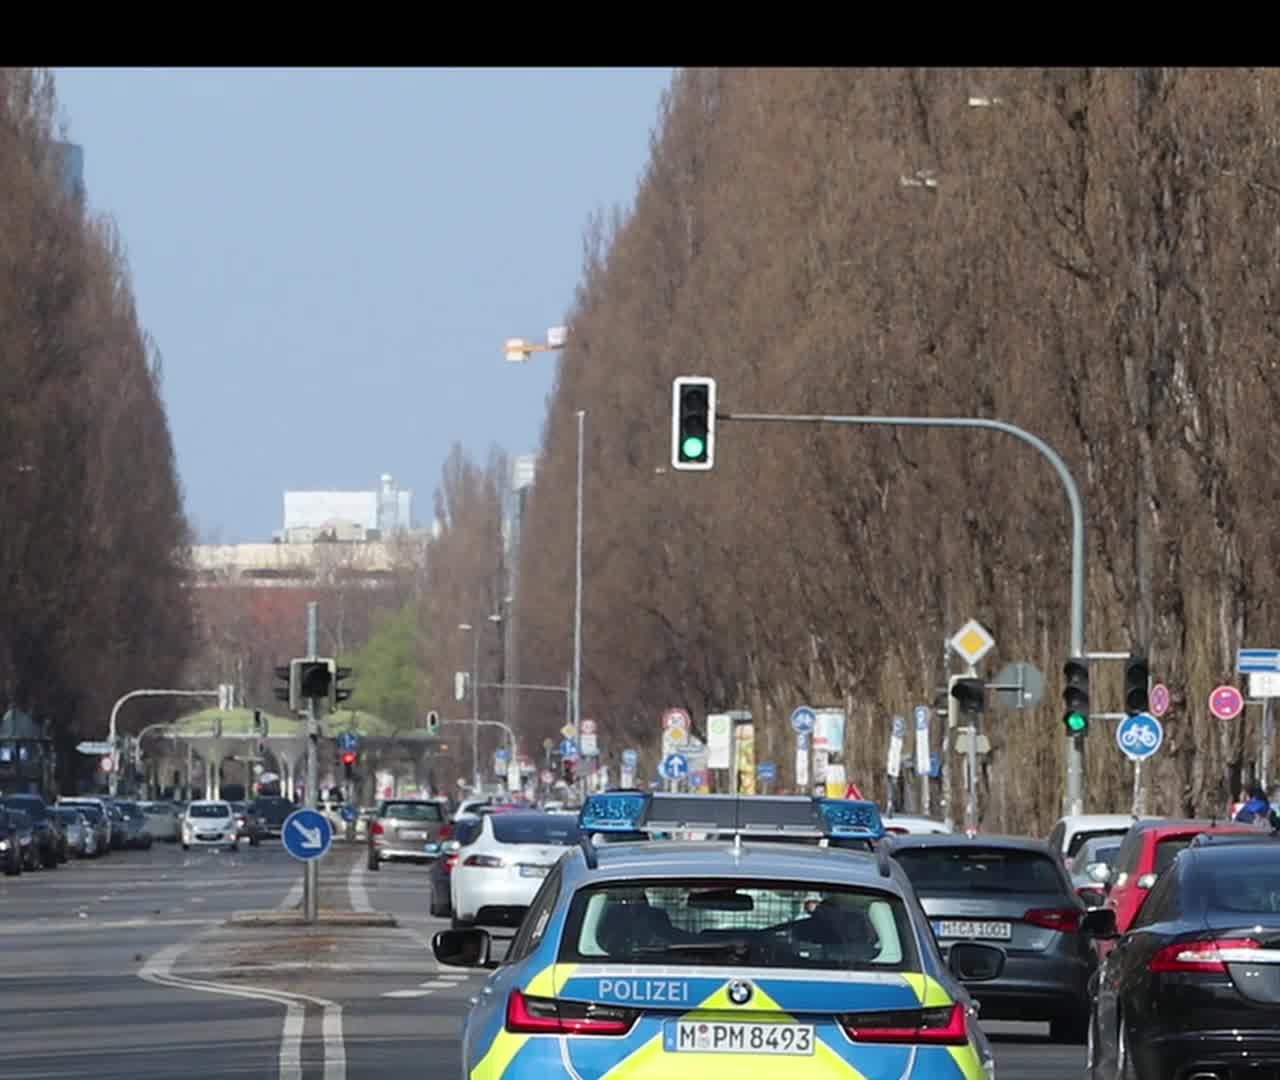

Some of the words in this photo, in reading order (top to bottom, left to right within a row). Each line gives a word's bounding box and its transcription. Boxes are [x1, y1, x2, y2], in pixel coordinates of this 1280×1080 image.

[598, 978, 688, 1001] POLIZEI
[679, 1026, 696, 1048] M
[713, 1027, 744, 1049] PM
[749, 1026, 811, 1051] 8493
